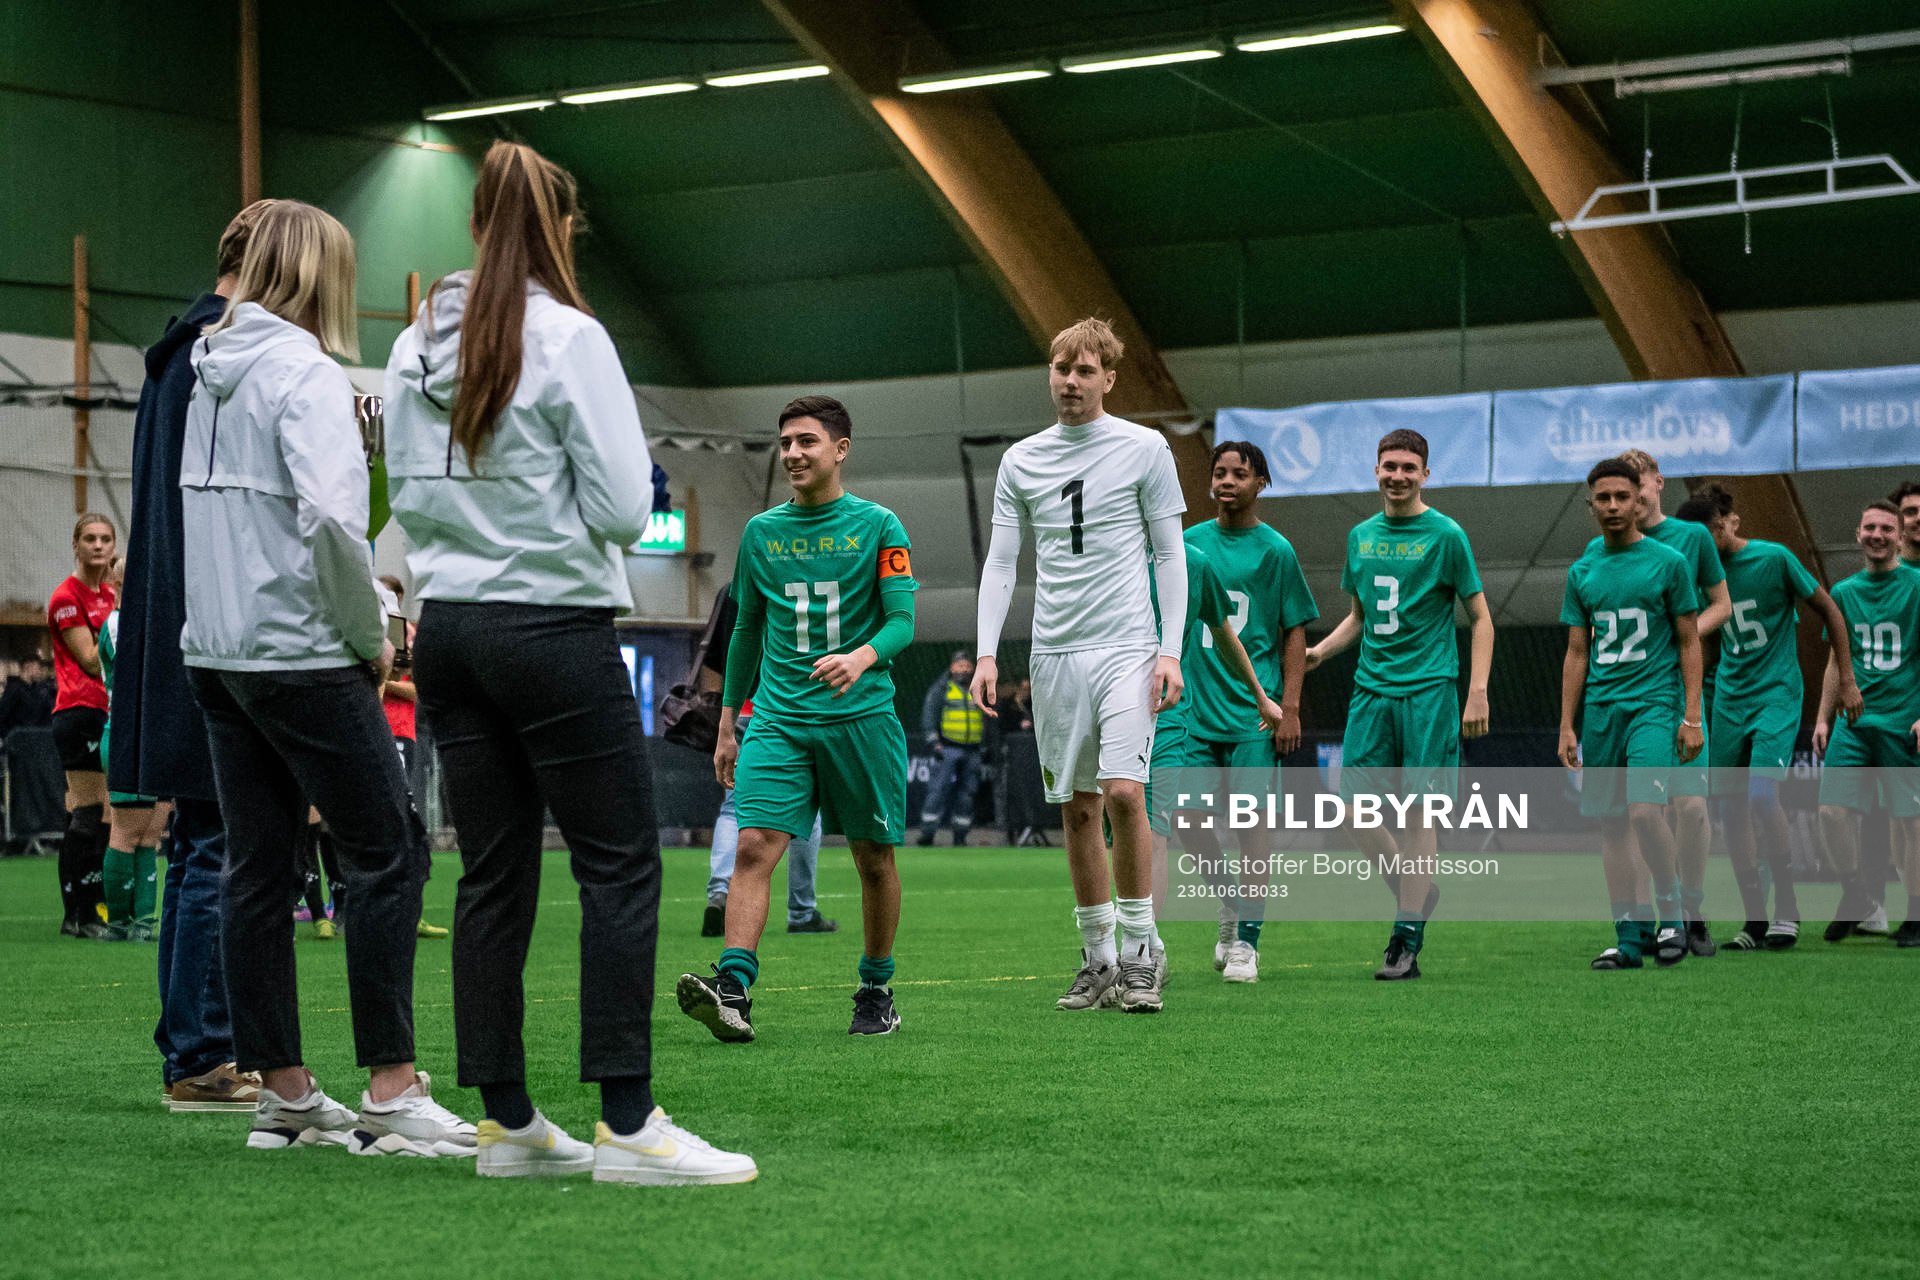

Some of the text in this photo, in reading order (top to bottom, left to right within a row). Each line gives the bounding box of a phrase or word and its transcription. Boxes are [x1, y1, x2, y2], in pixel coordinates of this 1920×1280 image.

[1061, 479, 1085, 555] 1
[888, 549, 907, 573] C
[784, 581, 841, 653] 11
[1373, 575, 1400, 635] 3
[1593, 607, 1649, 664] 22
[1854, 621, 1902, 671] 10
